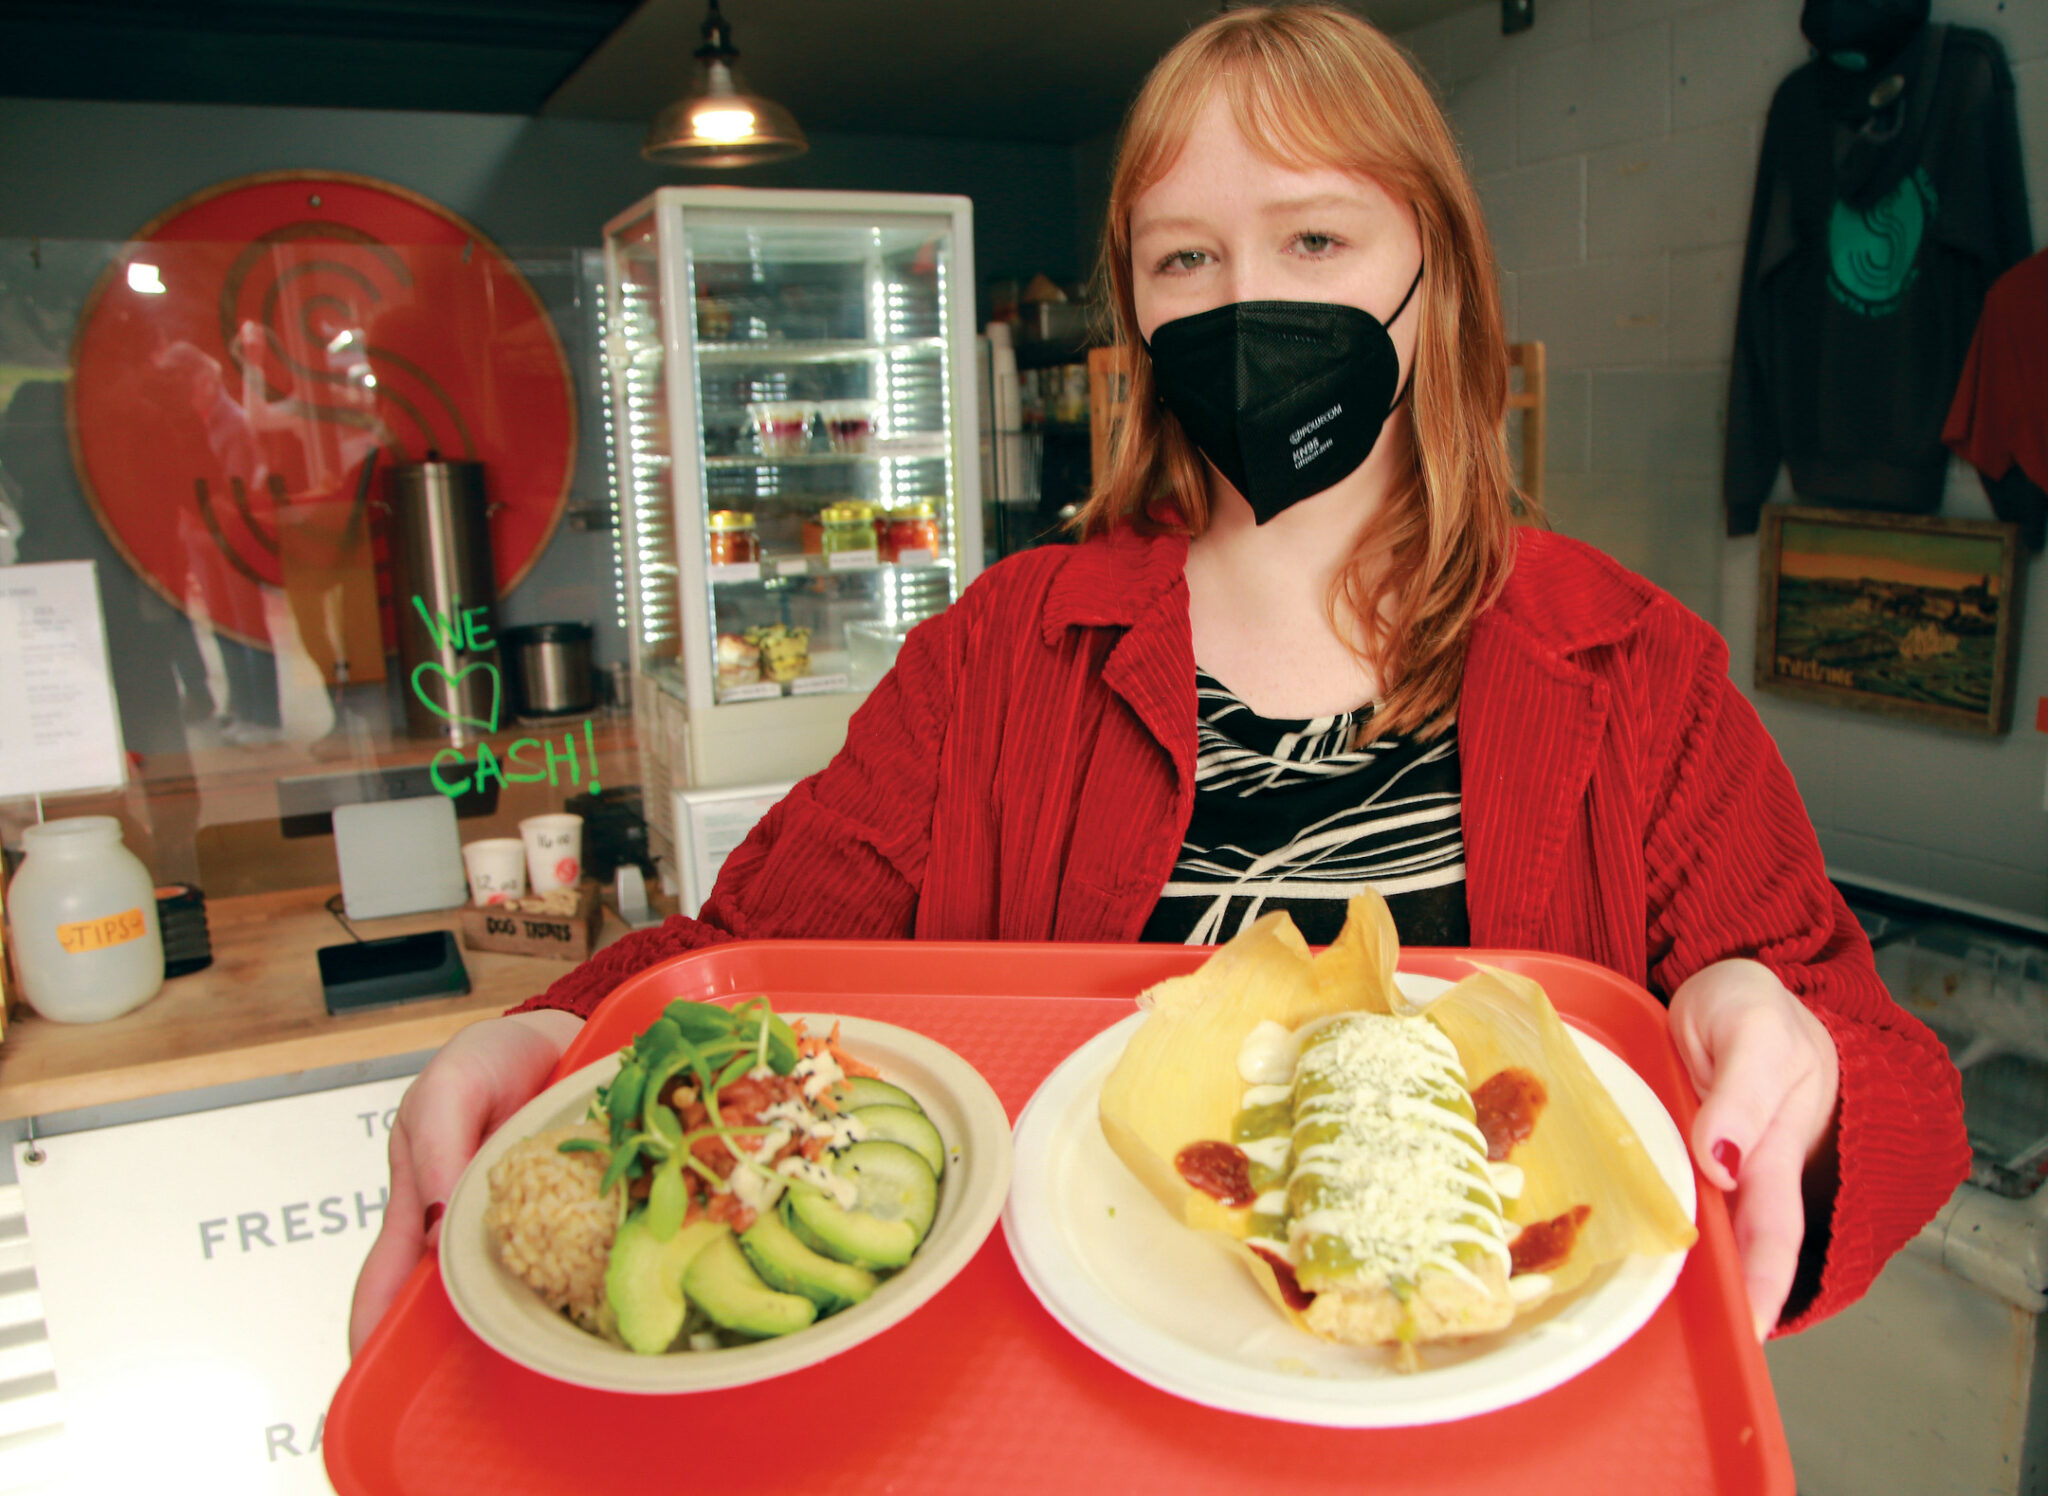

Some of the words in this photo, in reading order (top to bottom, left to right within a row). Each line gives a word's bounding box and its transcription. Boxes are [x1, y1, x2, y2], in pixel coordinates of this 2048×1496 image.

[412, 593, 497, 652] WE
[430, 719, 602, 798] CASH!
[71, 917, 131, 948] TIPS
[485, 916, 517, 936] DOG
[199, 1186, 389, 1260] FRESH
